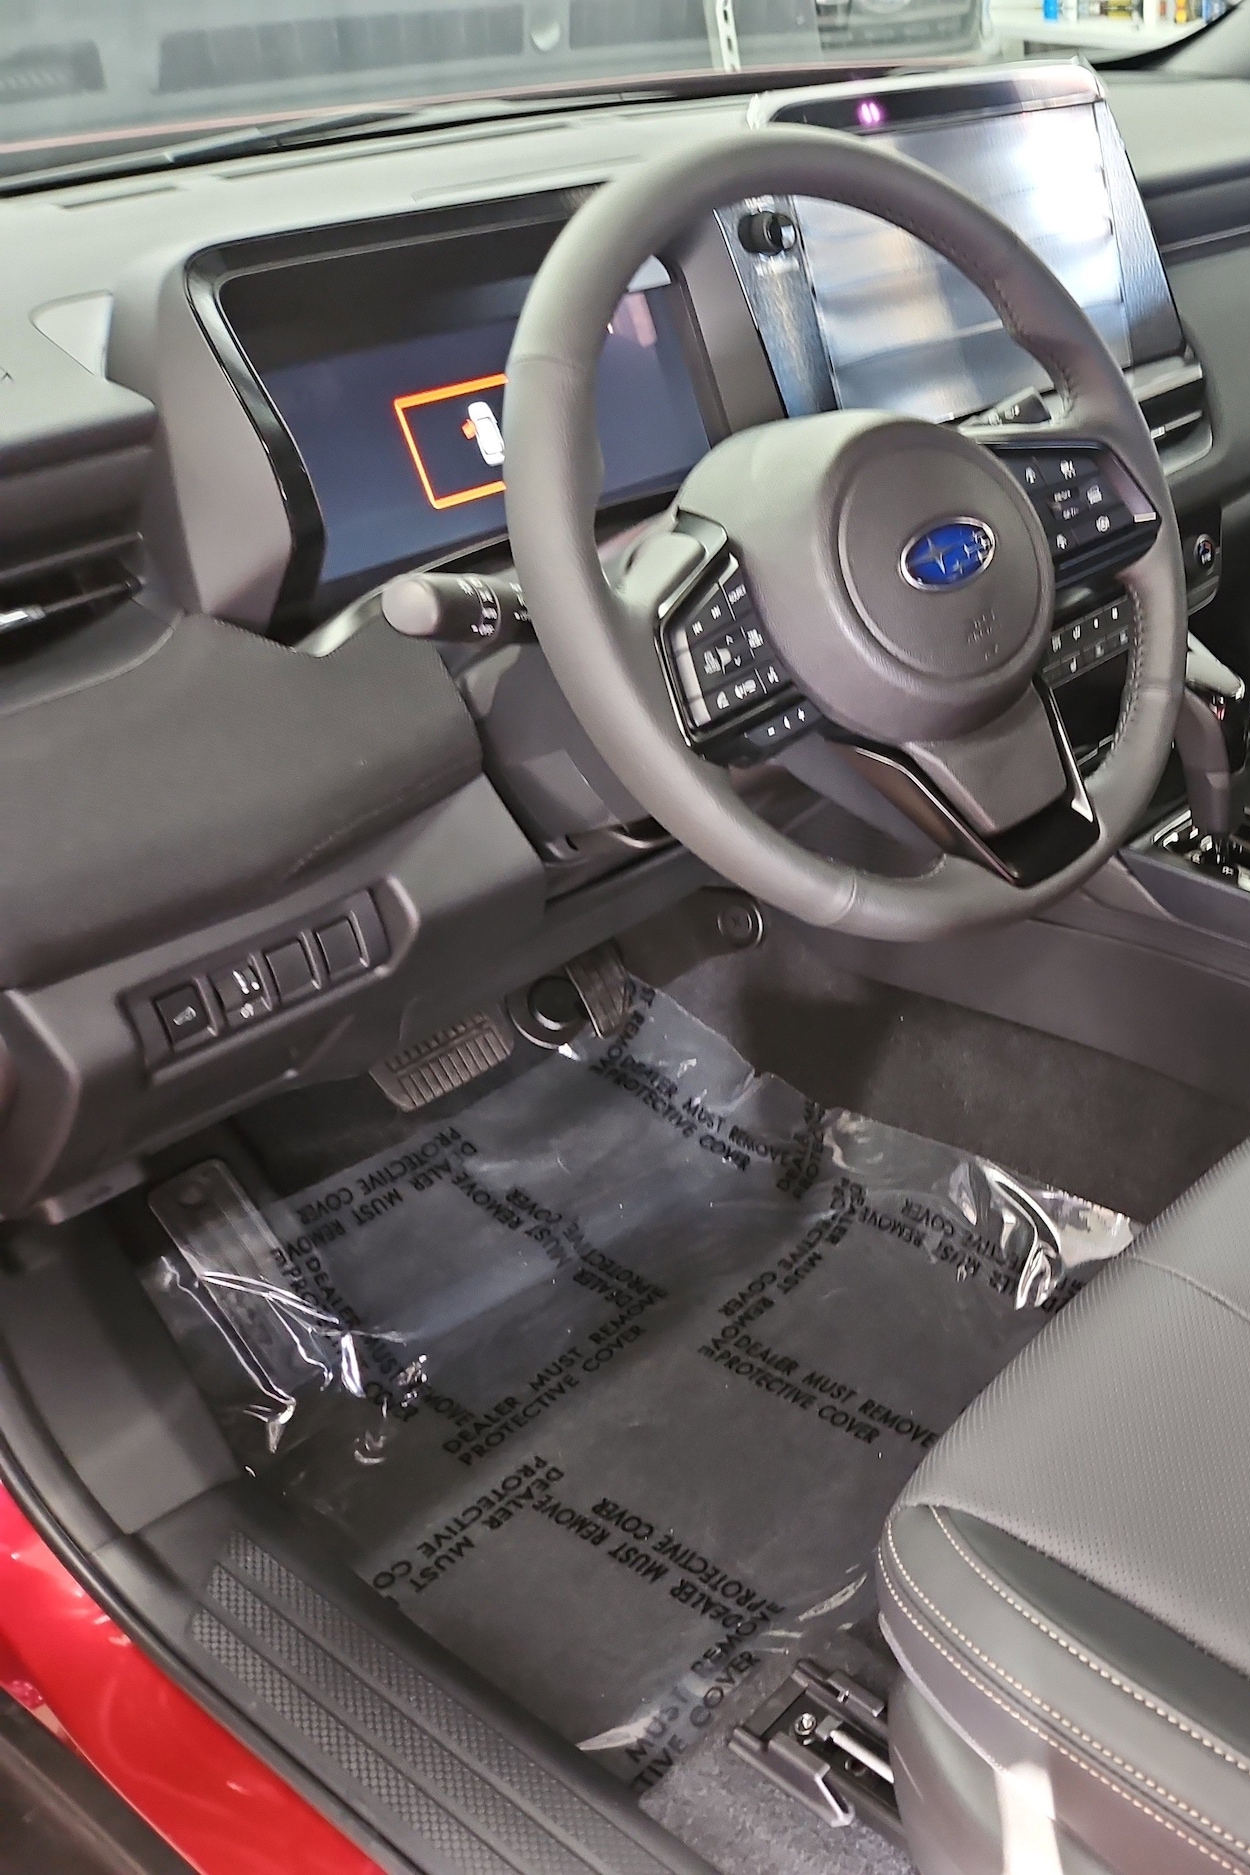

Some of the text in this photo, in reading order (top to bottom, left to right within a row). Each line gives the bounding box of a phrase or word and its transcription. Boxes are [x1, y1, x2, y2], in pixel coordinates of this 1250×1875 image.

[297, 1126, 462, 1225] PROTECTIVE COVER
[699, 1134, 751, 1172] COVER
[351, 1187, 404, 1227] MUST
[451, 1171, 524, 1231] REMOVE
[505, 1187, 562, 1224] COVER
[901, 1198, 955, 1237] COVER
[718, 1271, 778, 1317] COVER
[776, 1251, 824, 1295] MUST
[442, 1286, 669, 1454] DEALER MUST REMOVE
[697, 1297, 775, 1361] REMOVE
[457, 1324, 648, 1466] PROTECTIVE COVER
[713, 1349, 881, 1445] PROTECTIVE COVER
[733, 1334, 941, 1449] DEALER MUST REMOVE
[409, 1465, 565, 1594] DEALER MUST
[416, 1455, 548, 1559] PROTECTIVE
[531, 1494, 743, 1628] DEALER MUST REMOVE
[591, 1497, 769, 1613] PROTECTIVE COVER
[689, 1650, 761, 1729] COVER
